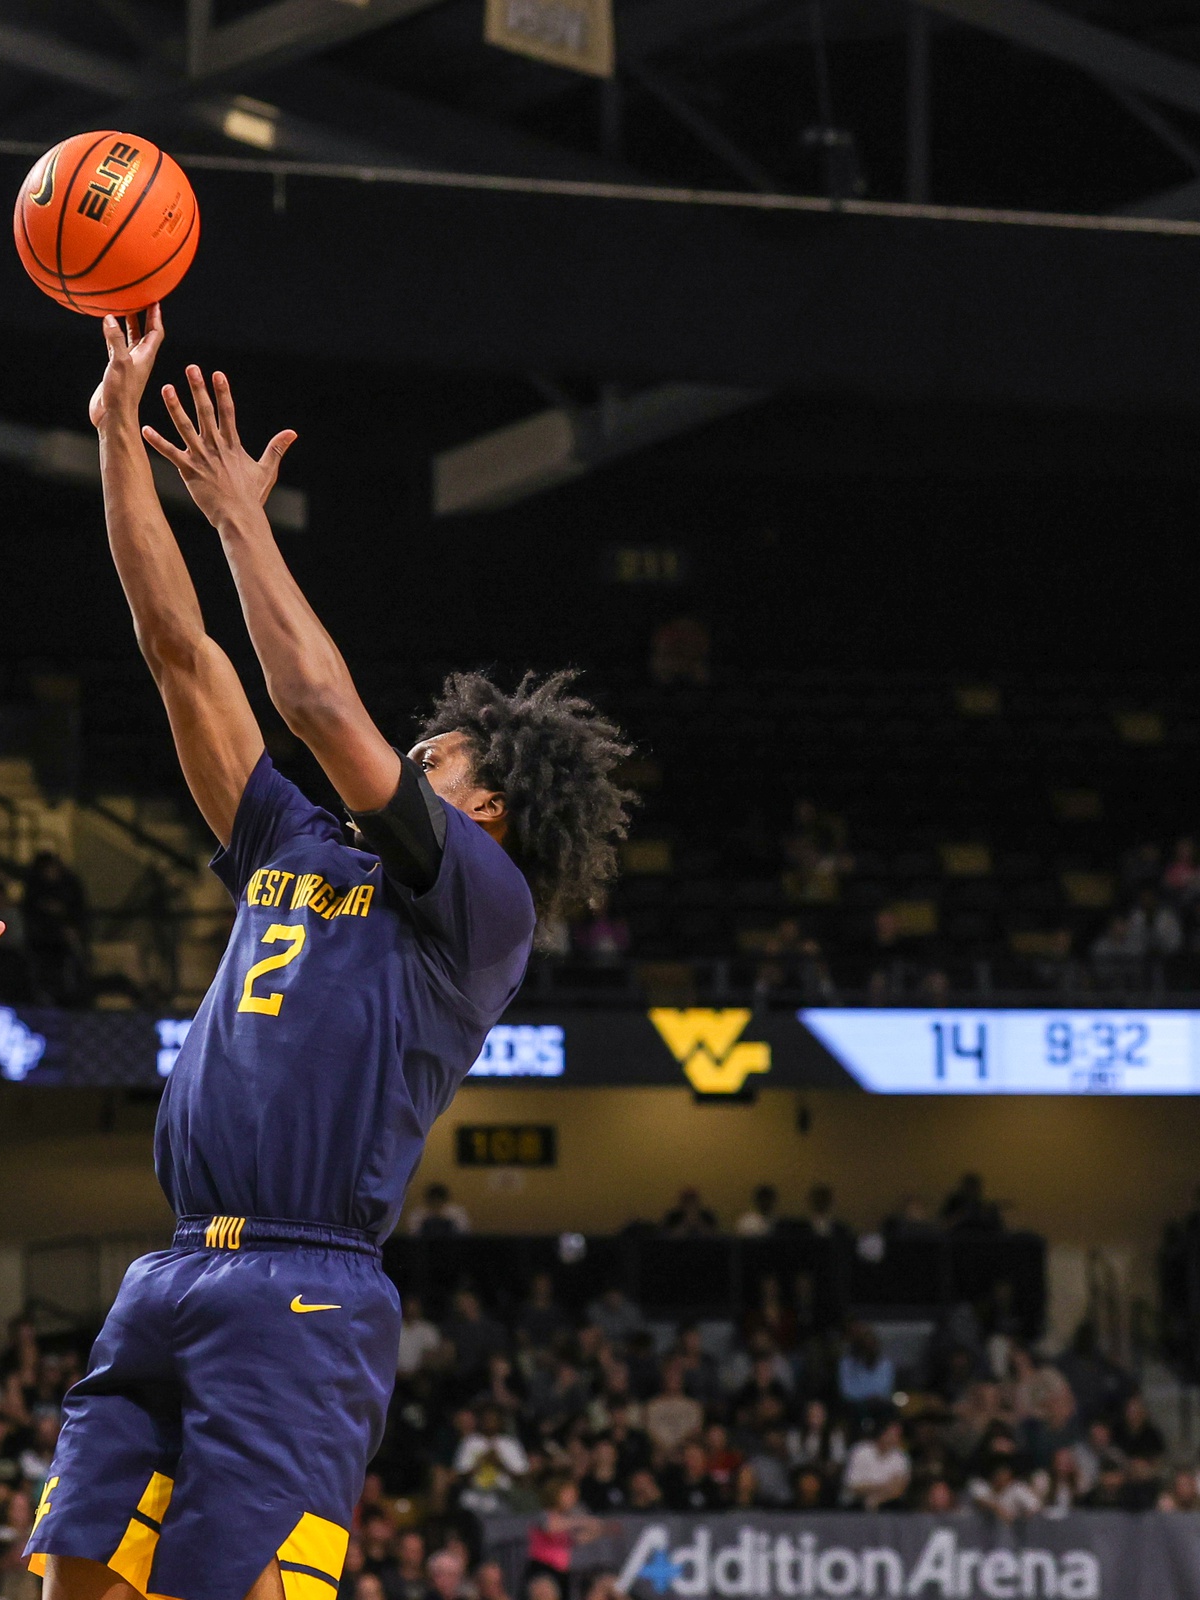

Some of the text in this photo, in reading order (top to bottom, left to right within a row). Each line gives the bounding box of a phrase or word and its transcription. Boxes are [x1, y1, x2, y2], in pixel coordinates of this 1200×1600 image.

[77, 141, 140, 222] ELITE
[237, 923, 307, 1017] 2
[932, 1022, 987, 1079] 14
[1045, 1021, 1149, 1067] 9:32
[614, 1526, 1099, 1598] Addition Arena
